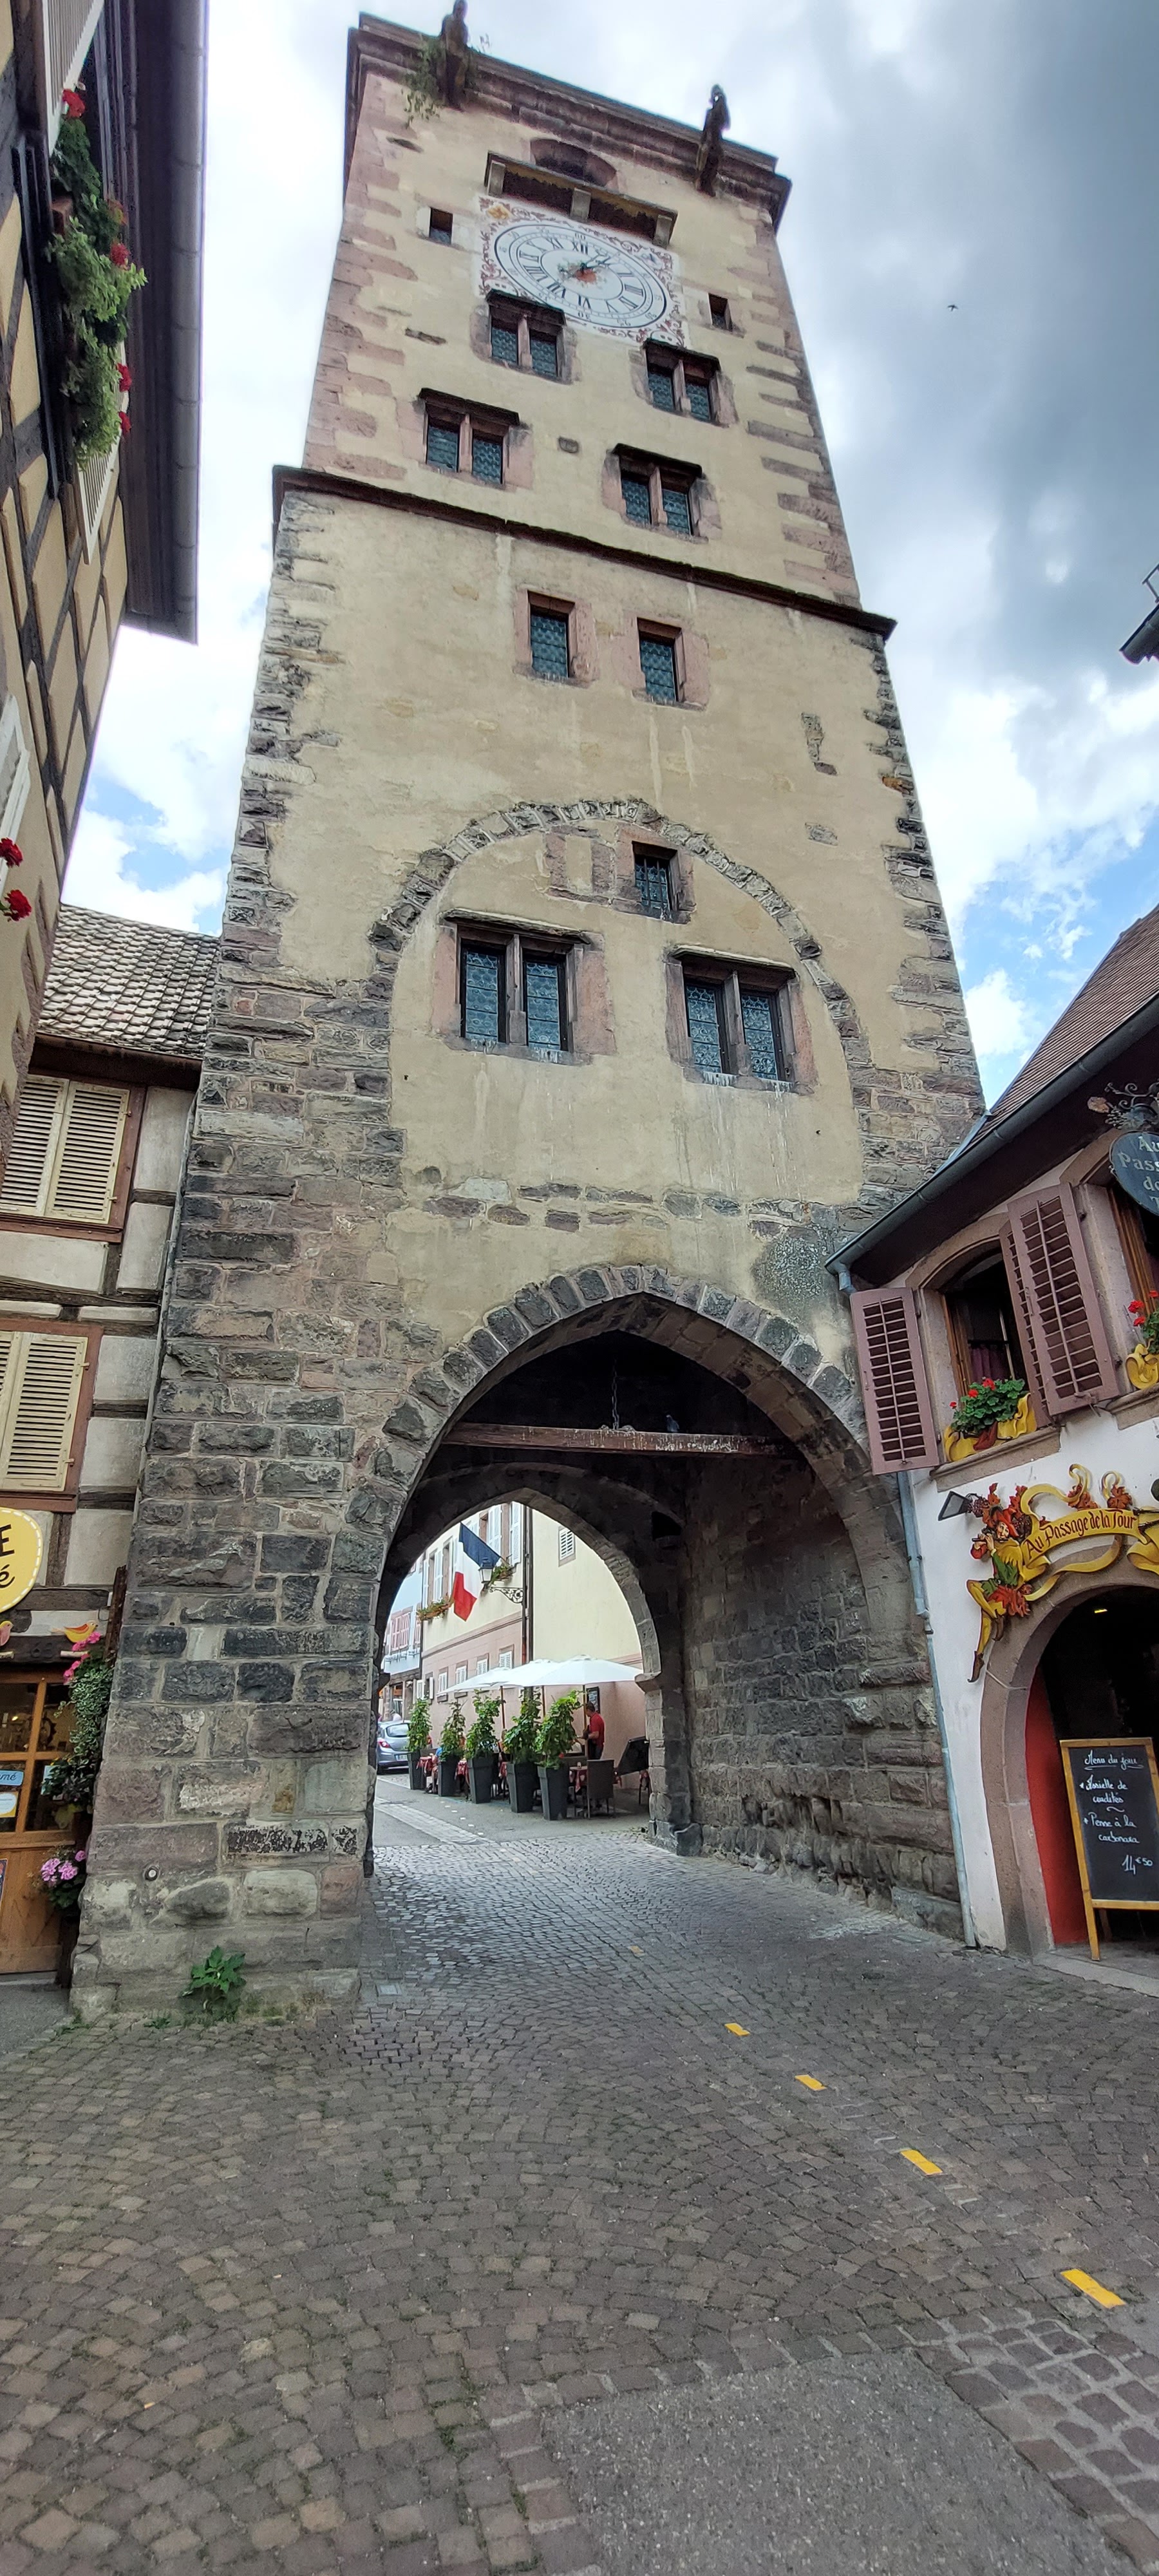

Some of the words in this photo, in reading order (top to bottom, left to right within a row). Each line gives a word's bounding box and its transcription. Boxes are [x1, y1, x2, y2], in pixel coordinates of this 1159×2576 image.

[571, 238, 588, 256] XII
[1138, 1135, 1159, 1152] Au
[1024, 1536, 1044, 1560] Au
[1039, 1516, 1089, 1546] Passage
[1088, 1511, 1100, 1530] de
[1098, 1510, 1111, 1528] la
[1105, 1508, 1137, 1530] Tour
[1084, 1750, 1106, 1765] Menu
[1107, 1754, 1118, 1764] du
[1120, 1753, 1138, 1770] jour
[1117, 1780, 1128, 1790] de
[1088, 1812, 1113, 1826] Penne
[1114, 1817, 1122, 1827] à
[1123, 1814, 1137, 1828] la
[1098, 1831, 1140, 1844] carbonara
